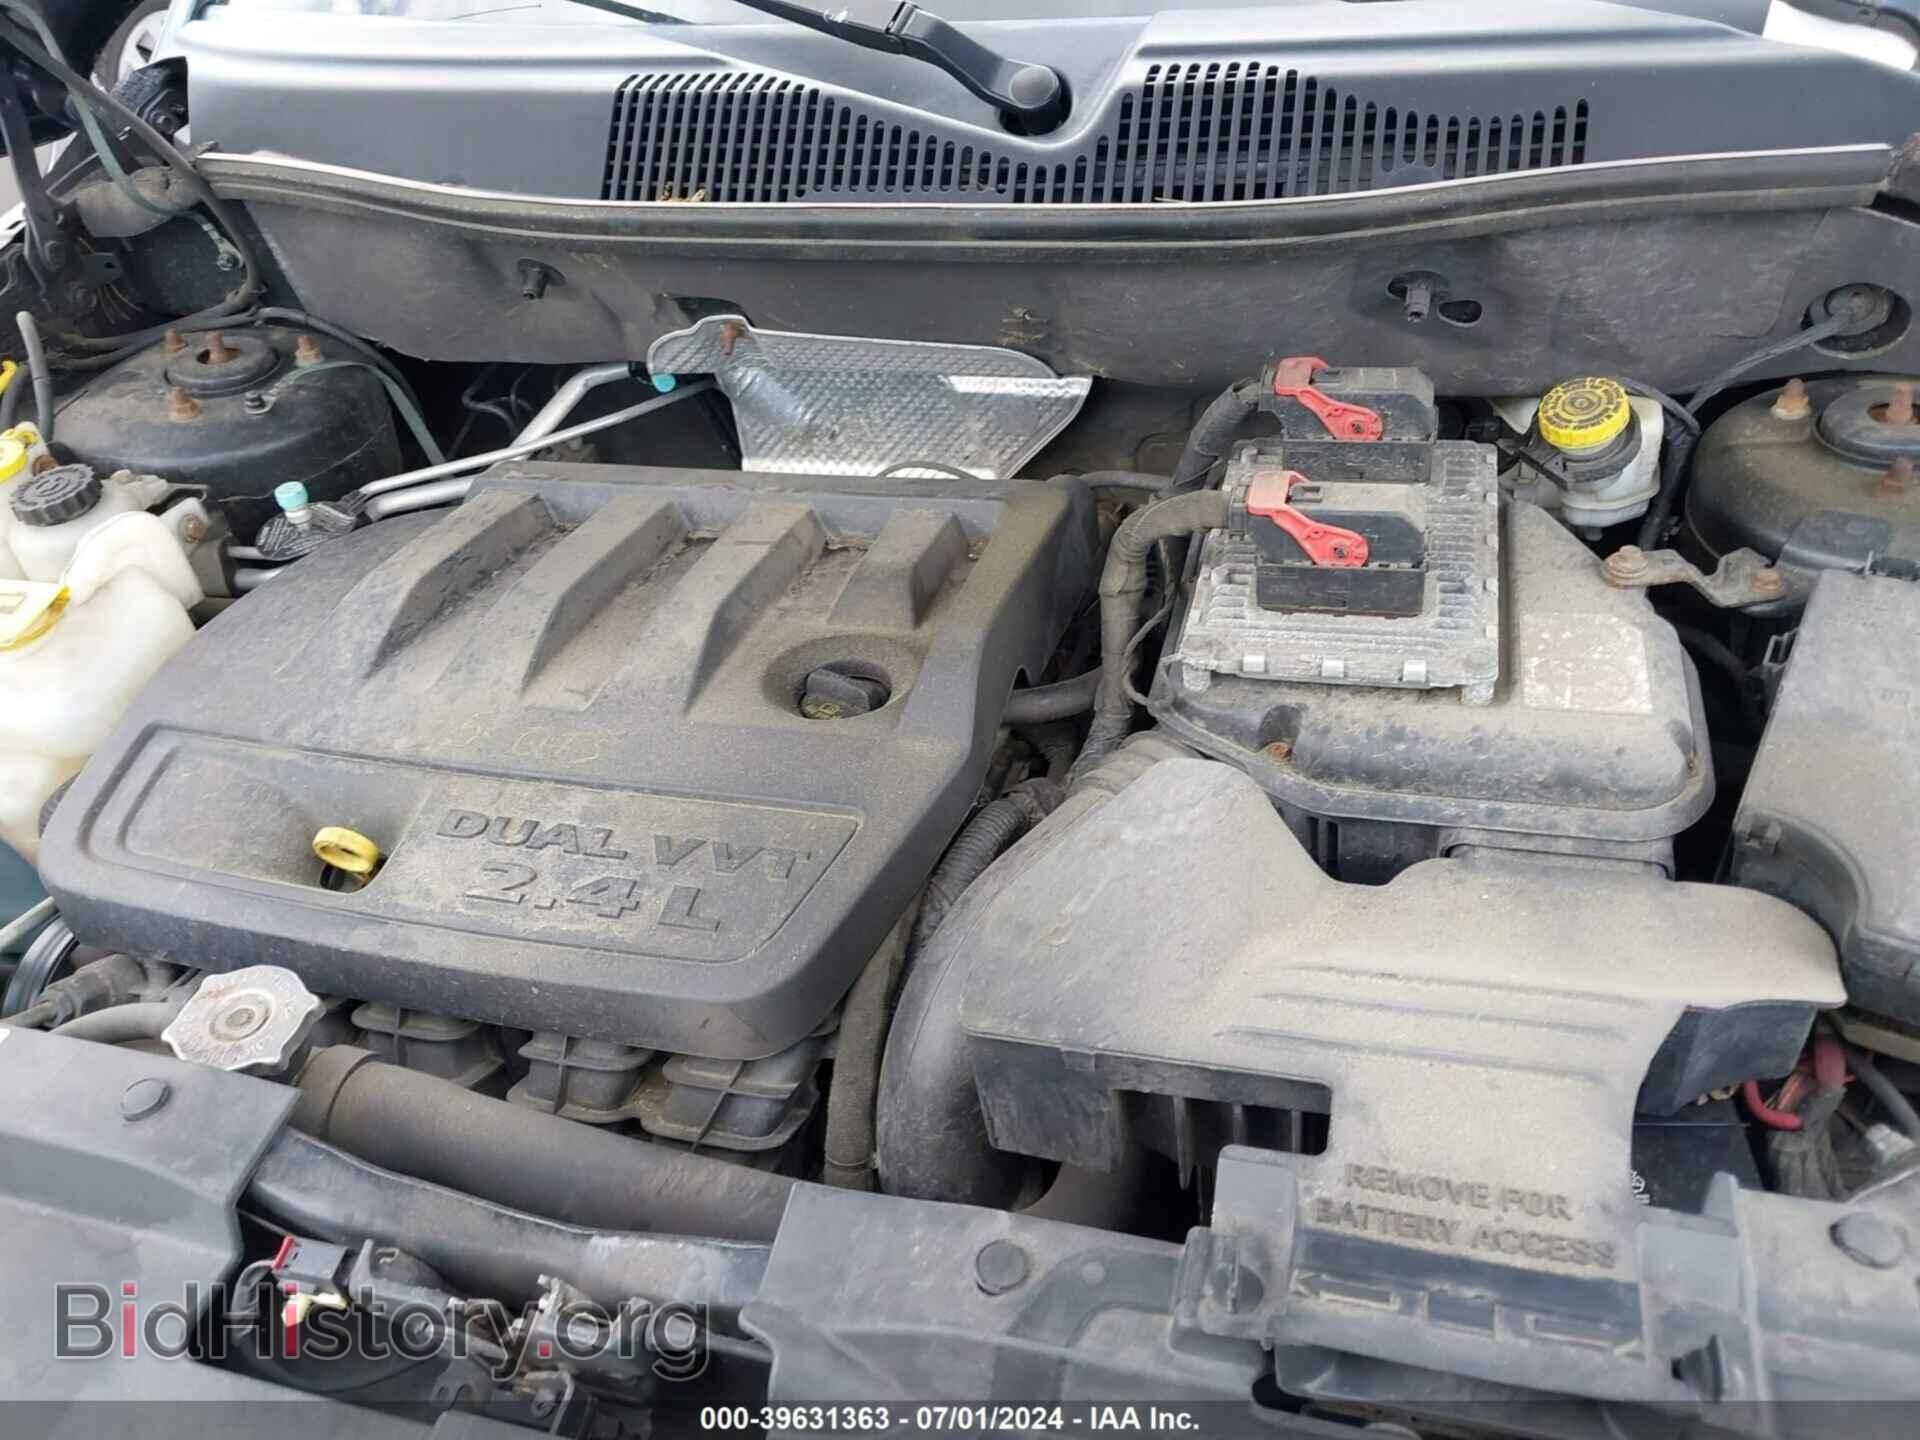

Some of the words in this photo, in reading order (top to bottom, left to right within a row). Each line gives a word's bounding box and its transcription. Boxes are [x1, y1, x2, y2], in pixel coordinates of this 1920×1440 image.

[436, 808, 628, 860] DUAL
[653, 834, 812, 880] VVT
[1346, 1162, 1490, 1210] REMOVE
[1500, 1187, 1574, 1222] FOR
[1315, 1200, 1461, 1246] BATTERY
[1470, 1225, 1618, 1270] ACCESS
